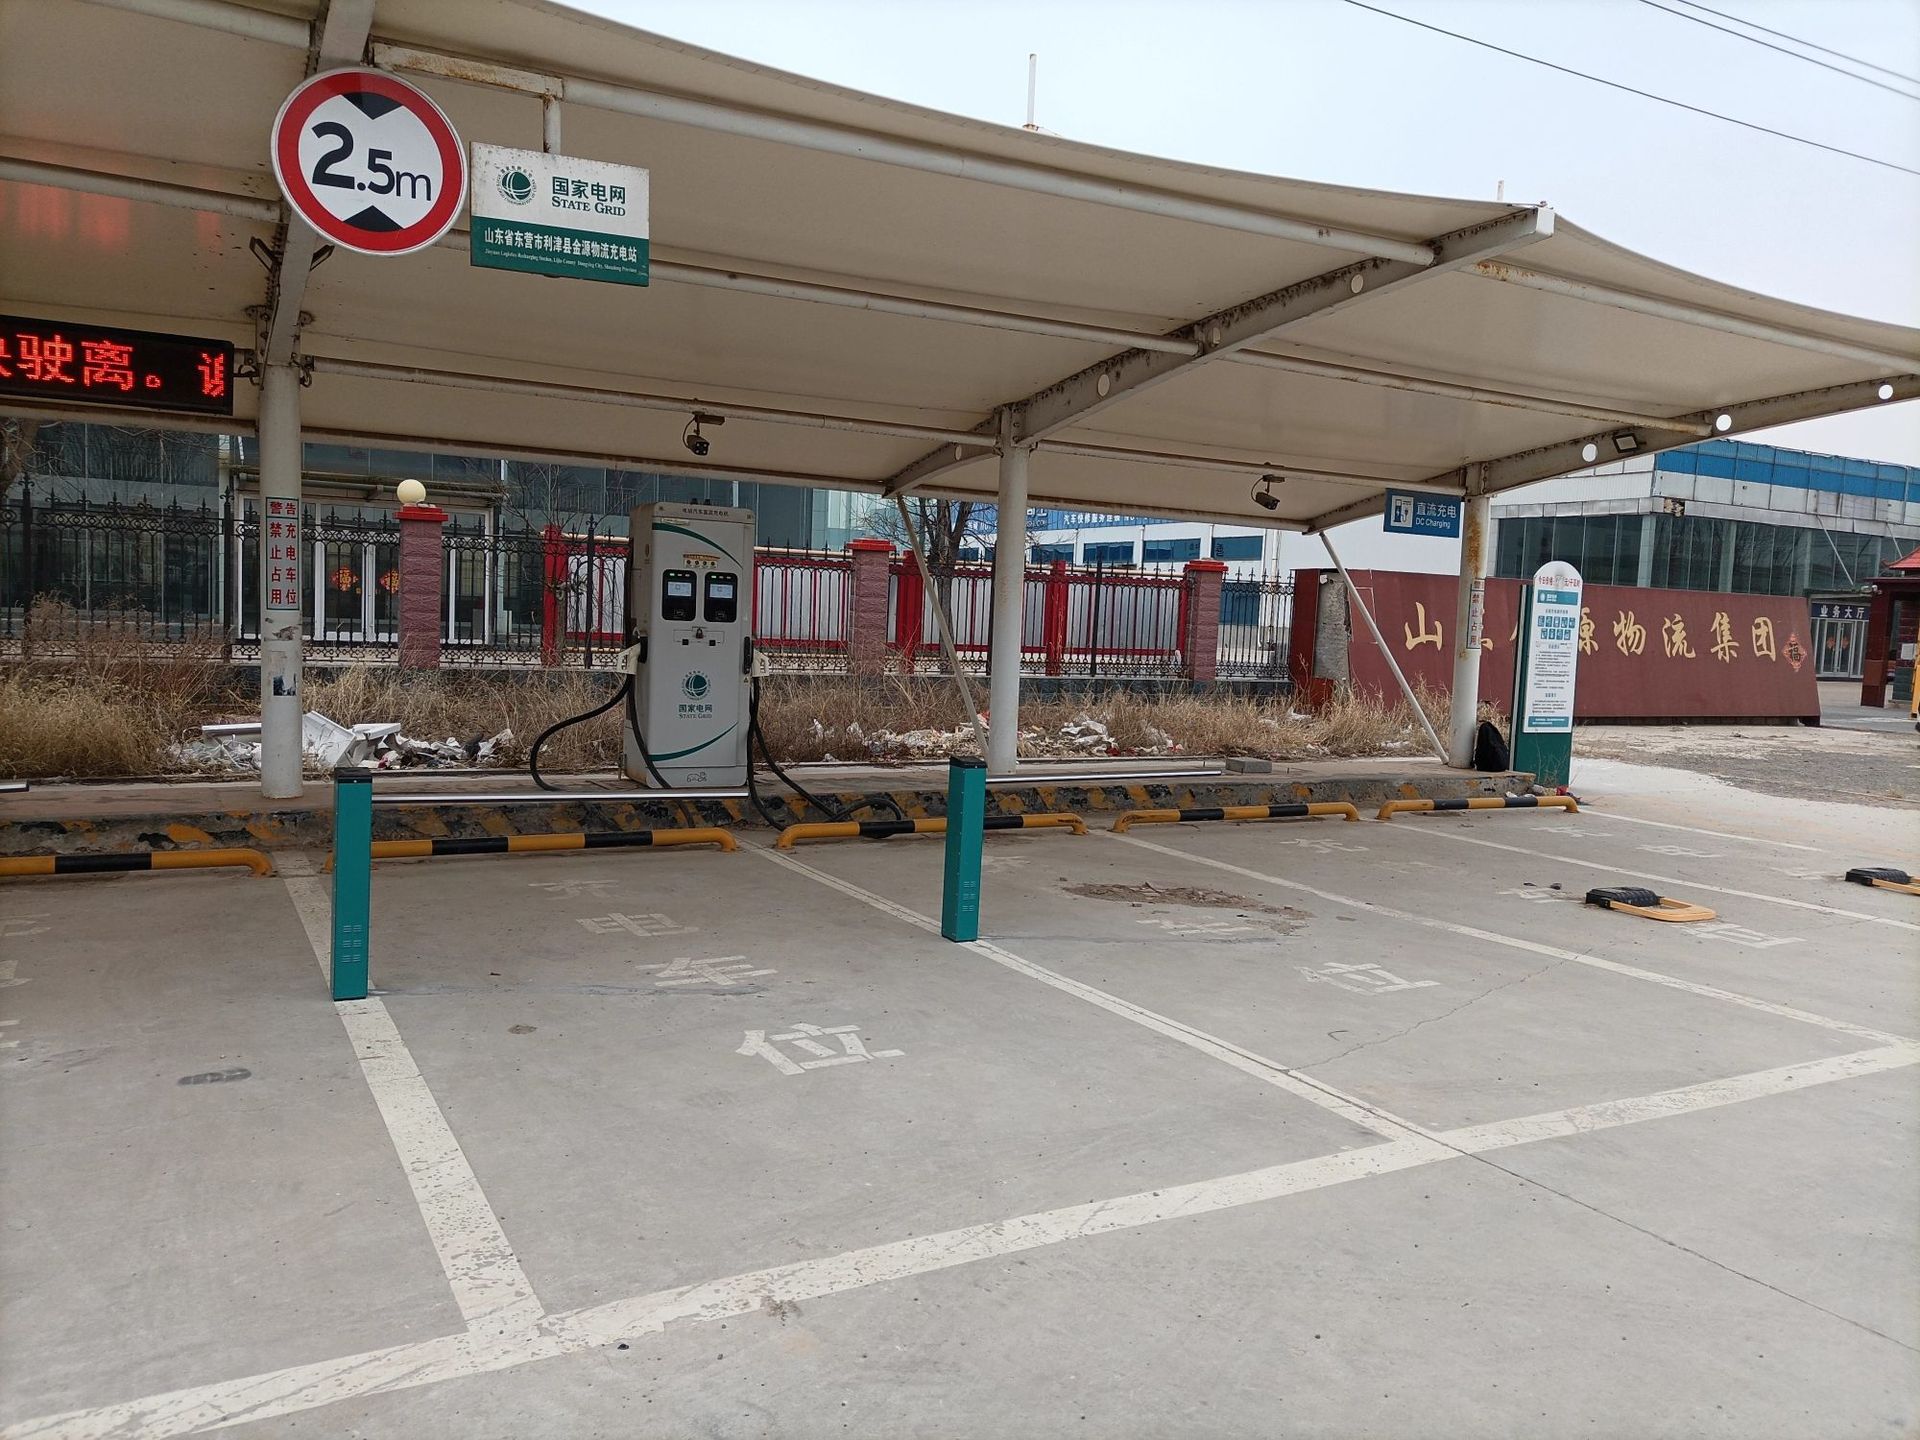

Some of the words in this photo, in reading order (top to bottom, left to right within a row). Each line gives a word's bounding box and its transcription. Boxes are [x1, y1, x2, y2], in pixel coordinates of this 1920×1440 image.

[311, 120, 432, 202] 2.5m
[552, 176, 626, 205] 国家电网
[484, 226, 638, 263] 山东省东营市利津县金源物流充电站
[270, 501, 297, 516] 警告
[1416, 502, 1457, 519] 直流充电
[1415, 517, 1425, 525] DC
[1425, 518, 1451, 529] Charging
[270, 522, 282, 605] 禁止占用
[285, 522, 297, 605] 充电车位
[1820, 605, 1865, 619] 业务大厅
[678, 704, 713, 713] 国家电网
